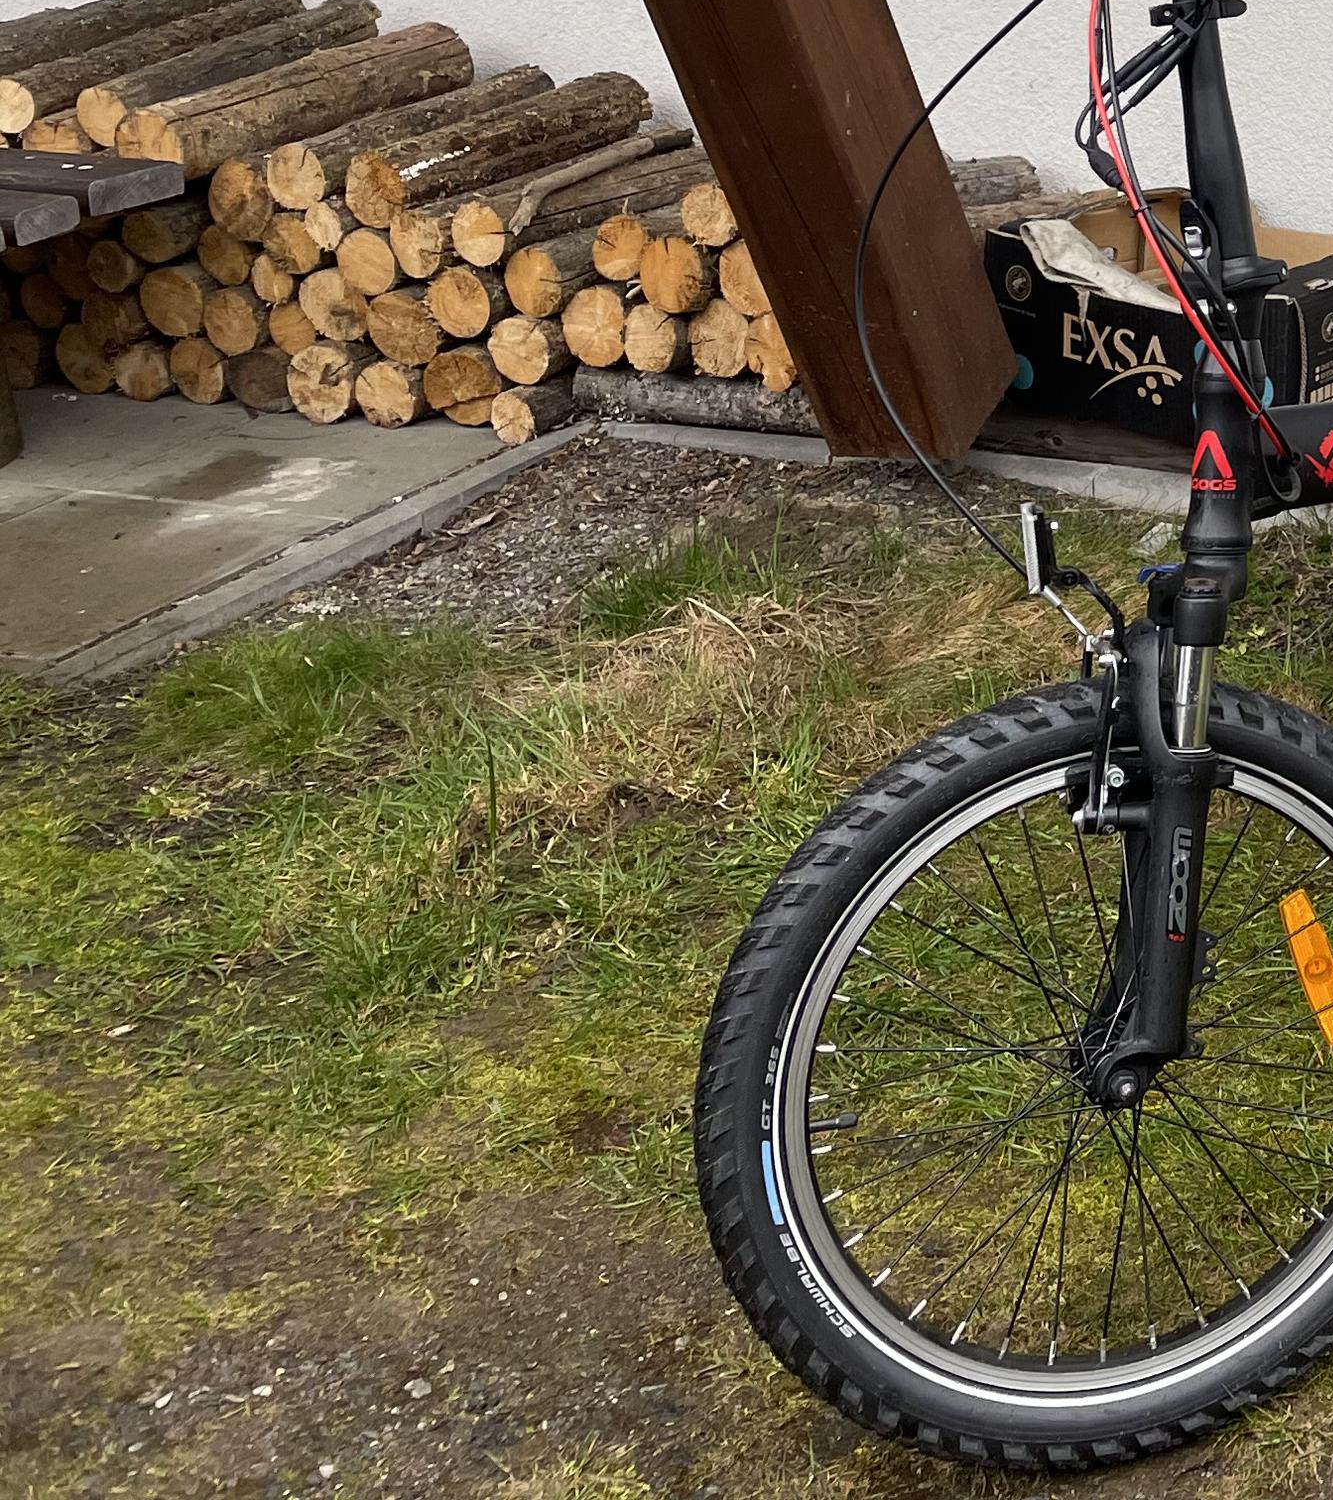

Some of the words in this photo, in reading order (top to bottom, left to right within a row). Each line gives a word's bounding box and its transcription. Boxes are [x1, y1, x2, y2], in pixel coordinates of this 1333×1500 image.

[1062, 311, 1176, 388] EXSA
[1167, 826, 1193, 934] ZOOM
[761, 1098, 772, 1131] GT
[778, 1232, 857, 1339] SCHWALBE
